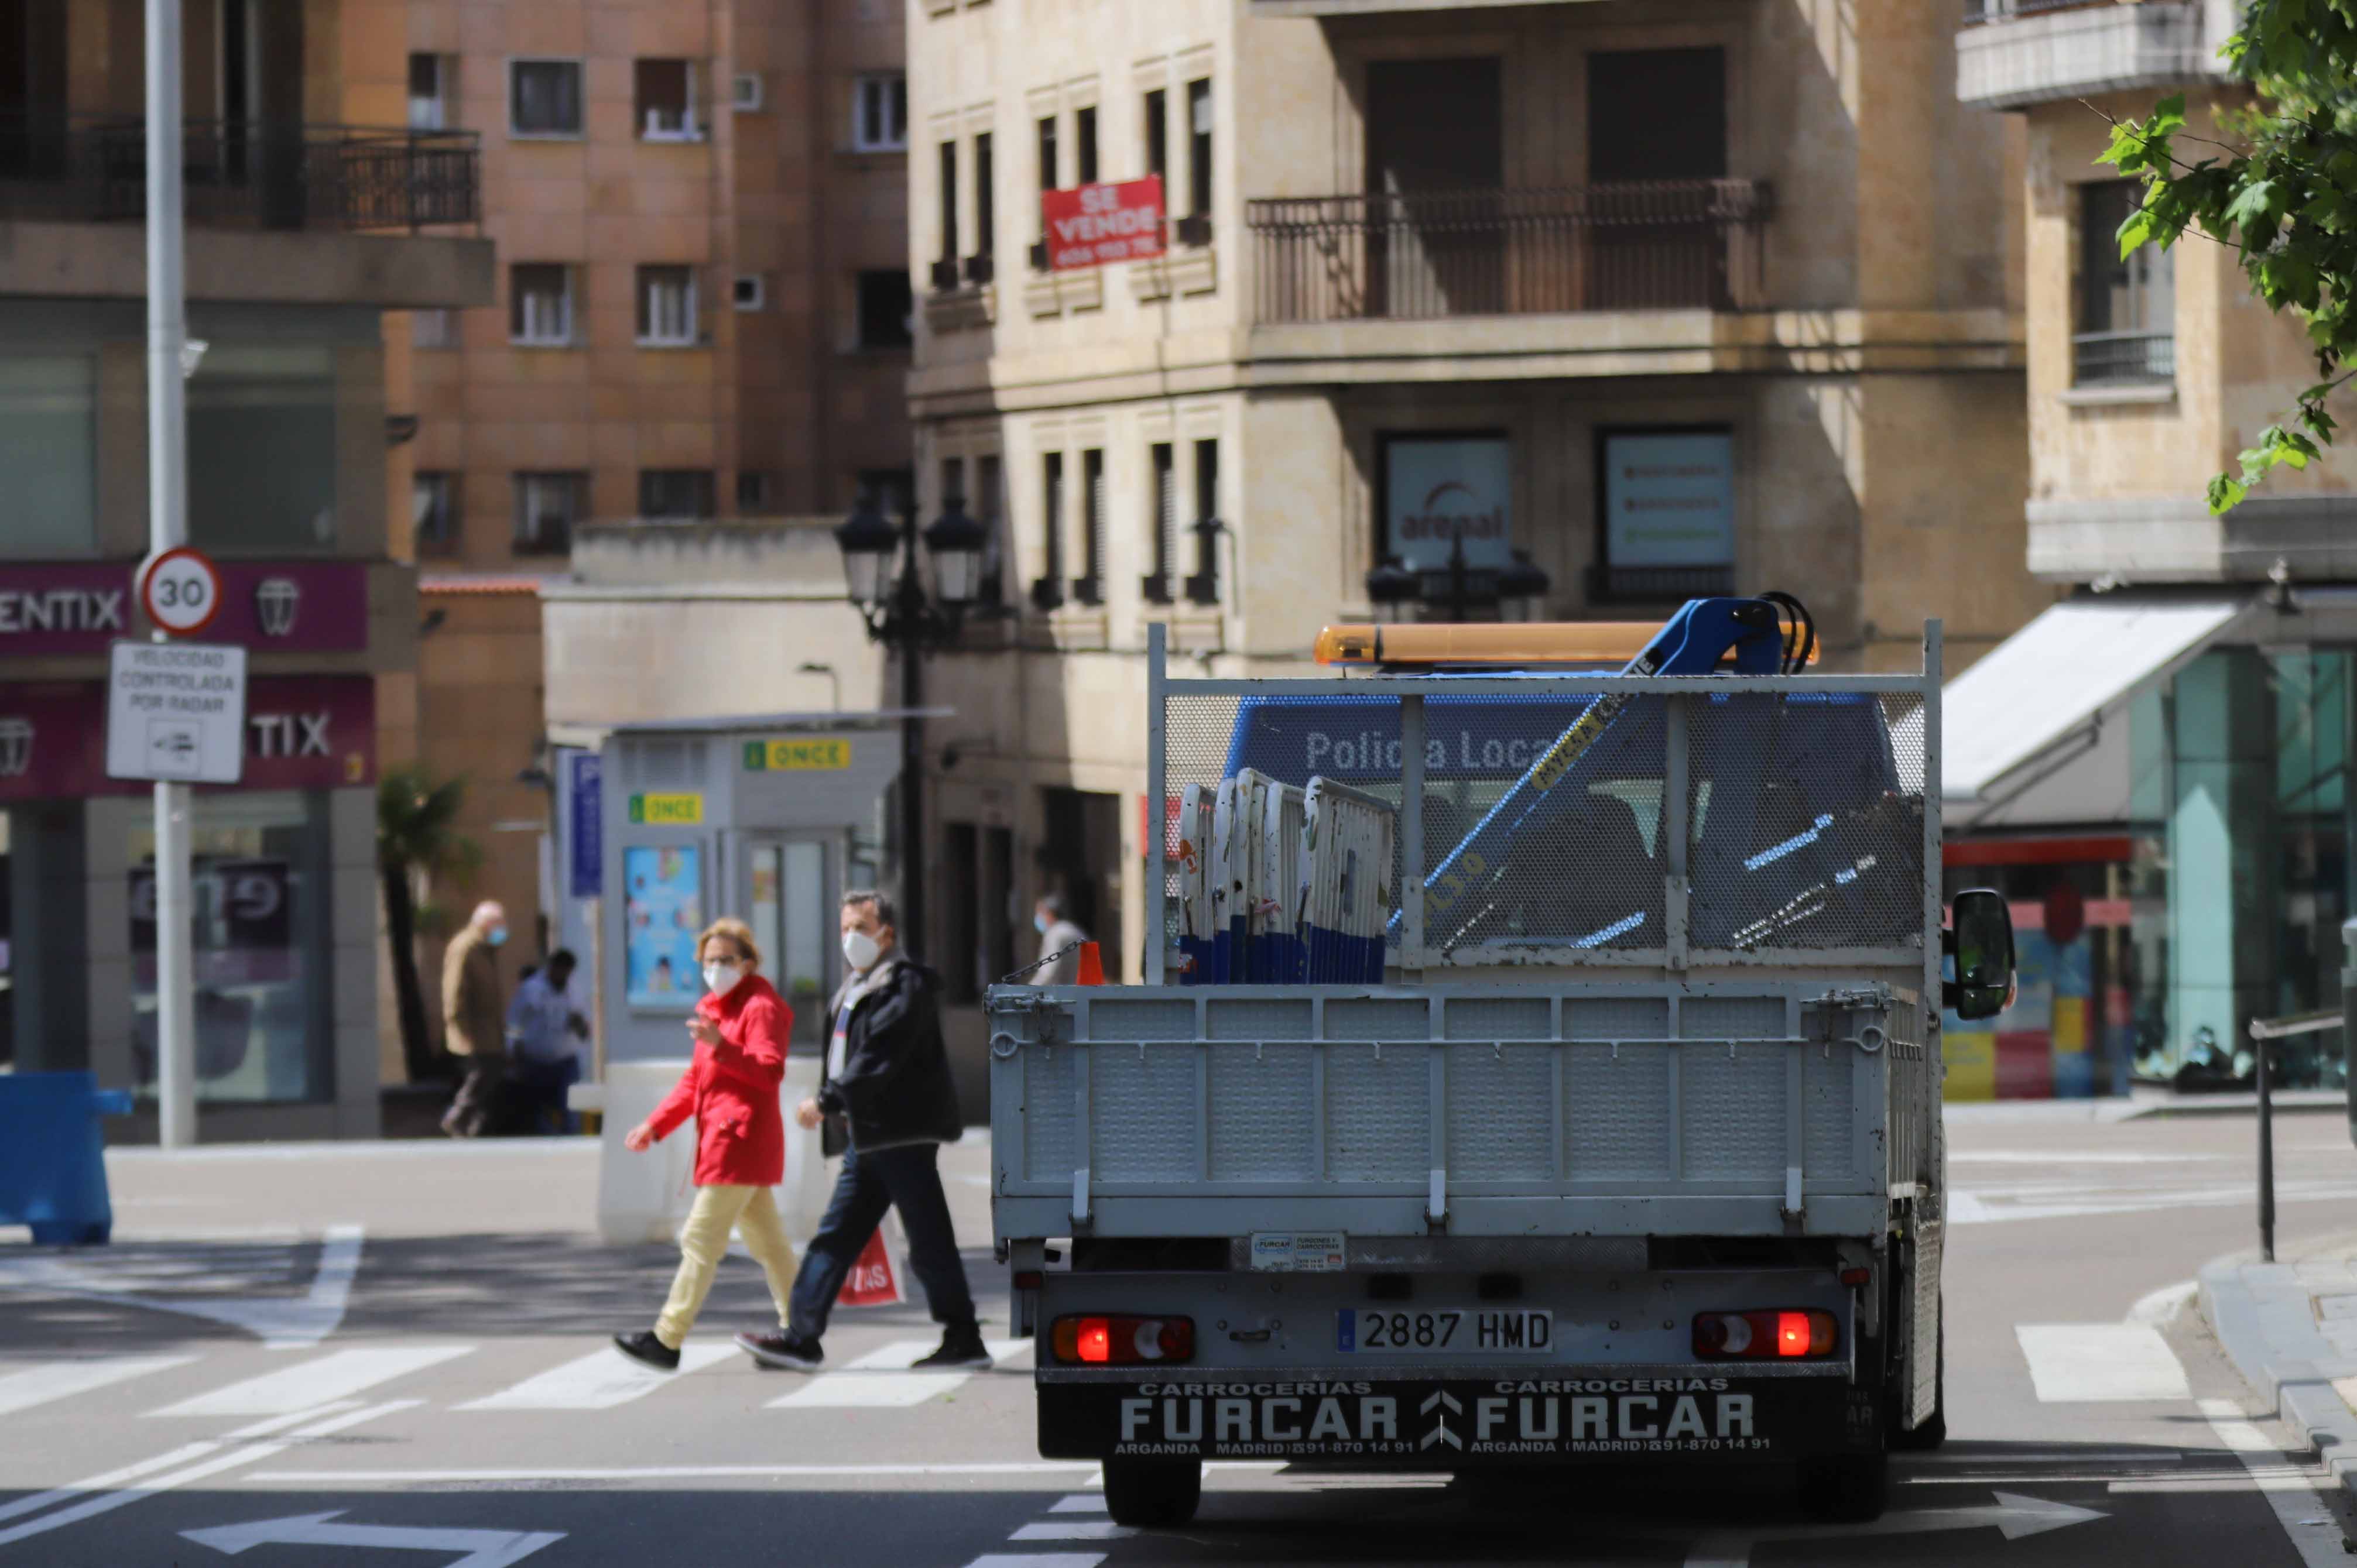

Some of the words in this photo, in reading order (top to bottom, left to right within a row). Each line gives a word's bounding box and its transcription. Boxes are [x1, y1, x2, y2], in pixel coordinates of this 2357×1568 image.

[1080, 186, 1118, 214] SE
[1053, 205, 1157, 243] VENDE
[159, 578, 205, 607] 30
[132, 650, 226, 668] VELOCIDAD
[119, 670, 235, 691] CONTROLADA
[129, 694, 164, 711] POR
[168, 695, 225, 713] RADAR
[774, 746, 840, 766] ONCE
[1306, 732, 1447, 770] Polica
[649, 799, 696, 819] ONCE
[1364, 1312, 1461, 1348] 2887
[1478, 1312, 1549, 1349] HMD
[1139, 1382, 1372, 1397] CARROCERIAS
[1495, 1378, 1729, 1394] CARROCERIAS
[1121, 1397, 1397, 1442] FURCAR
[1476, 1394, 1754, 1440] FURCAR
[1115, 1442, 1200, 1455] ARGANDA
[1370, 1442, 1389, 1453] 14
[1395, 1441, 1413, 1453] 91
[1470, 1440, 1556, 1453] ARGANDA
[1726, 1438, 1746, 1450] 14
[1751, 1438, 1770, 1450] 91
